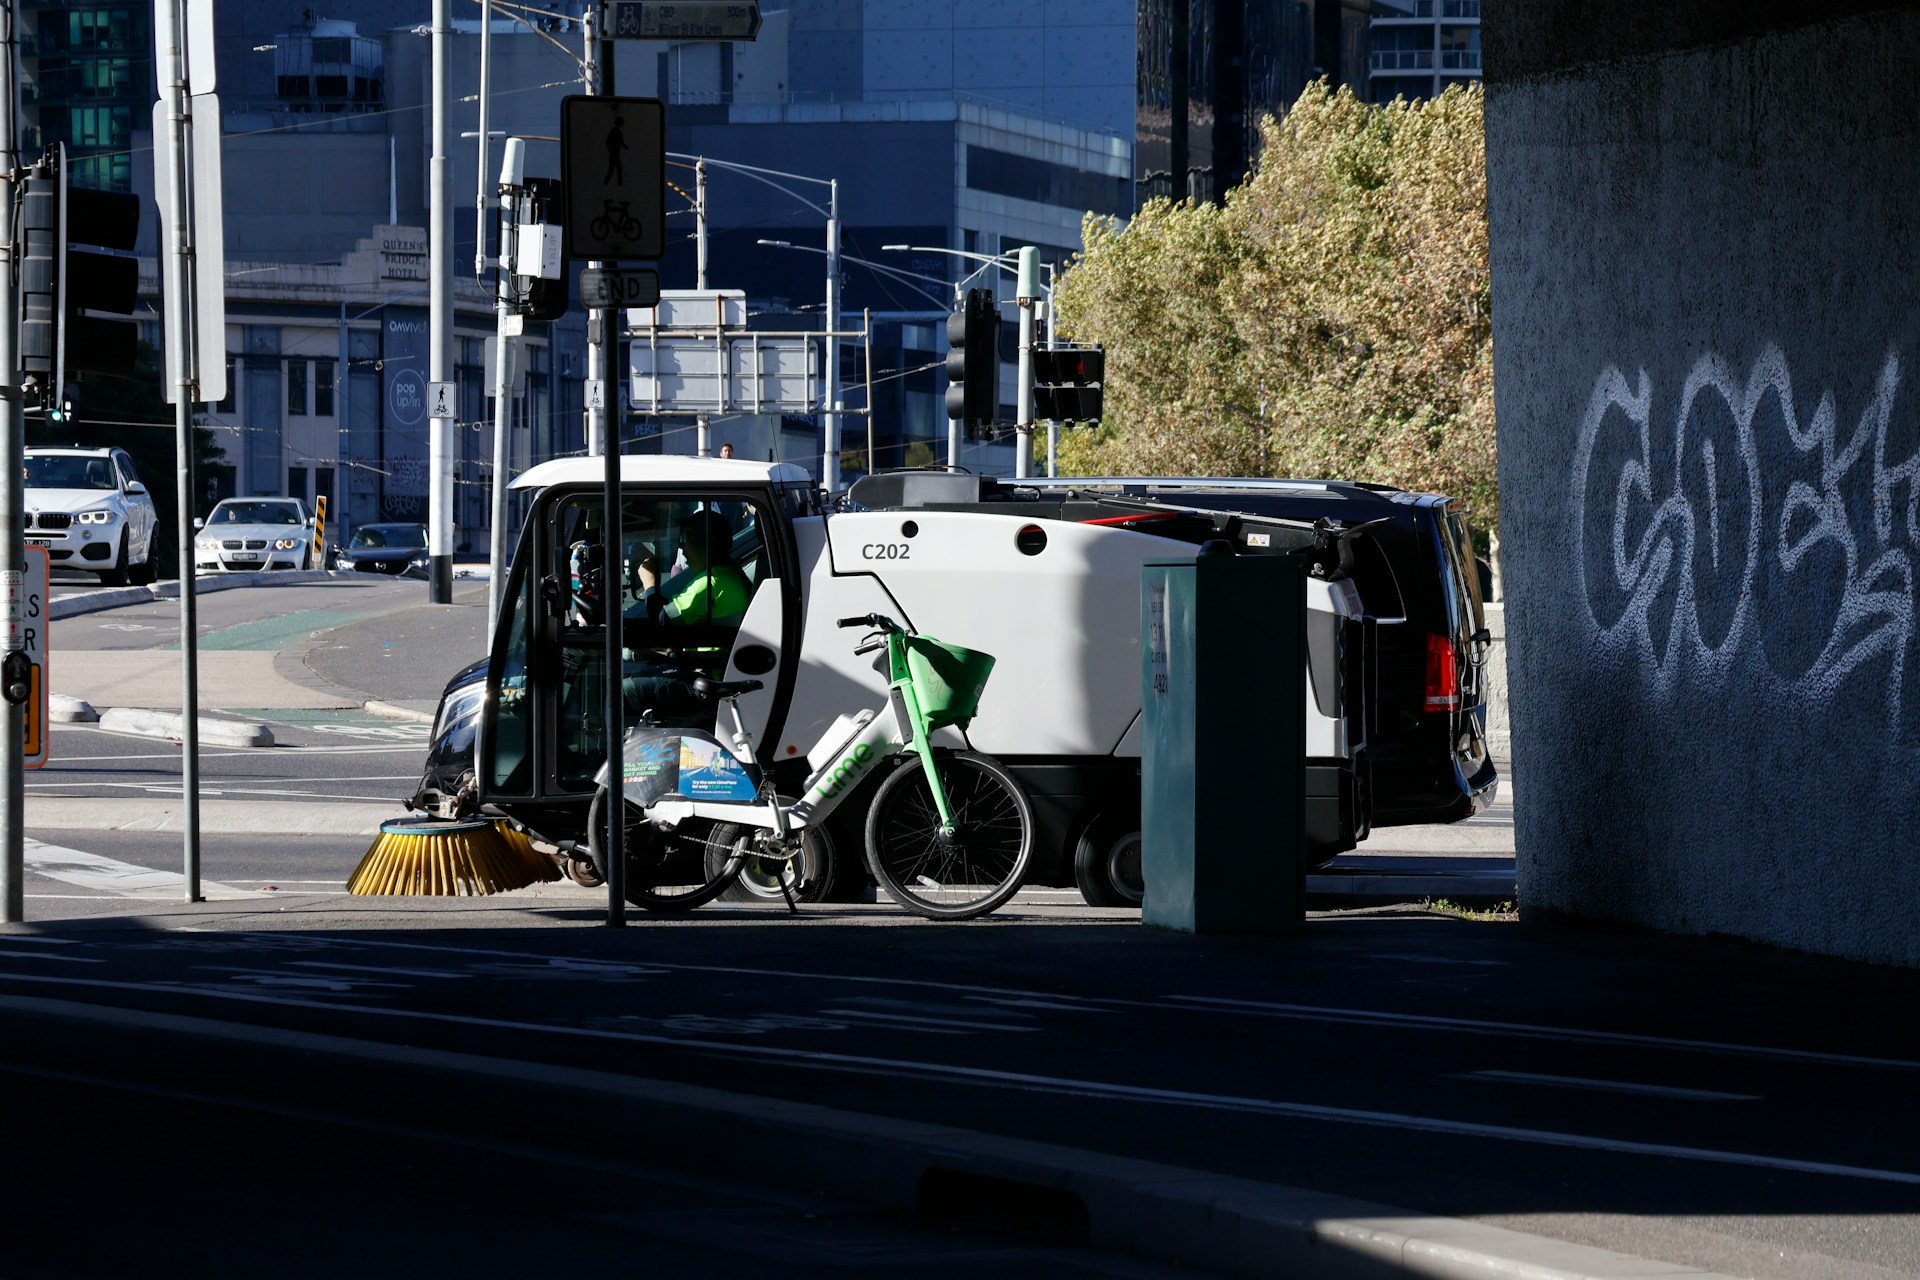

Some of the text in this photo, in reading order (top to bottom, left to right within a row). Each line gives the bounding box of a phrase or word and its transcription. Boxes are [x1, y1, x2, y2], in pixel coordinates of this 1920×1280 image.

[659, 6, 746, 18] CBD 500m
[383, 239, 425, 252] QUEEN'S
[385, 253, 421, 265] BRIDGE
[388, 267, 419, 279] HOTEL
[598, 277, 640, 300] END
[862, 543, 910, 560] C202
[815, 743, 874, 799] Lime
